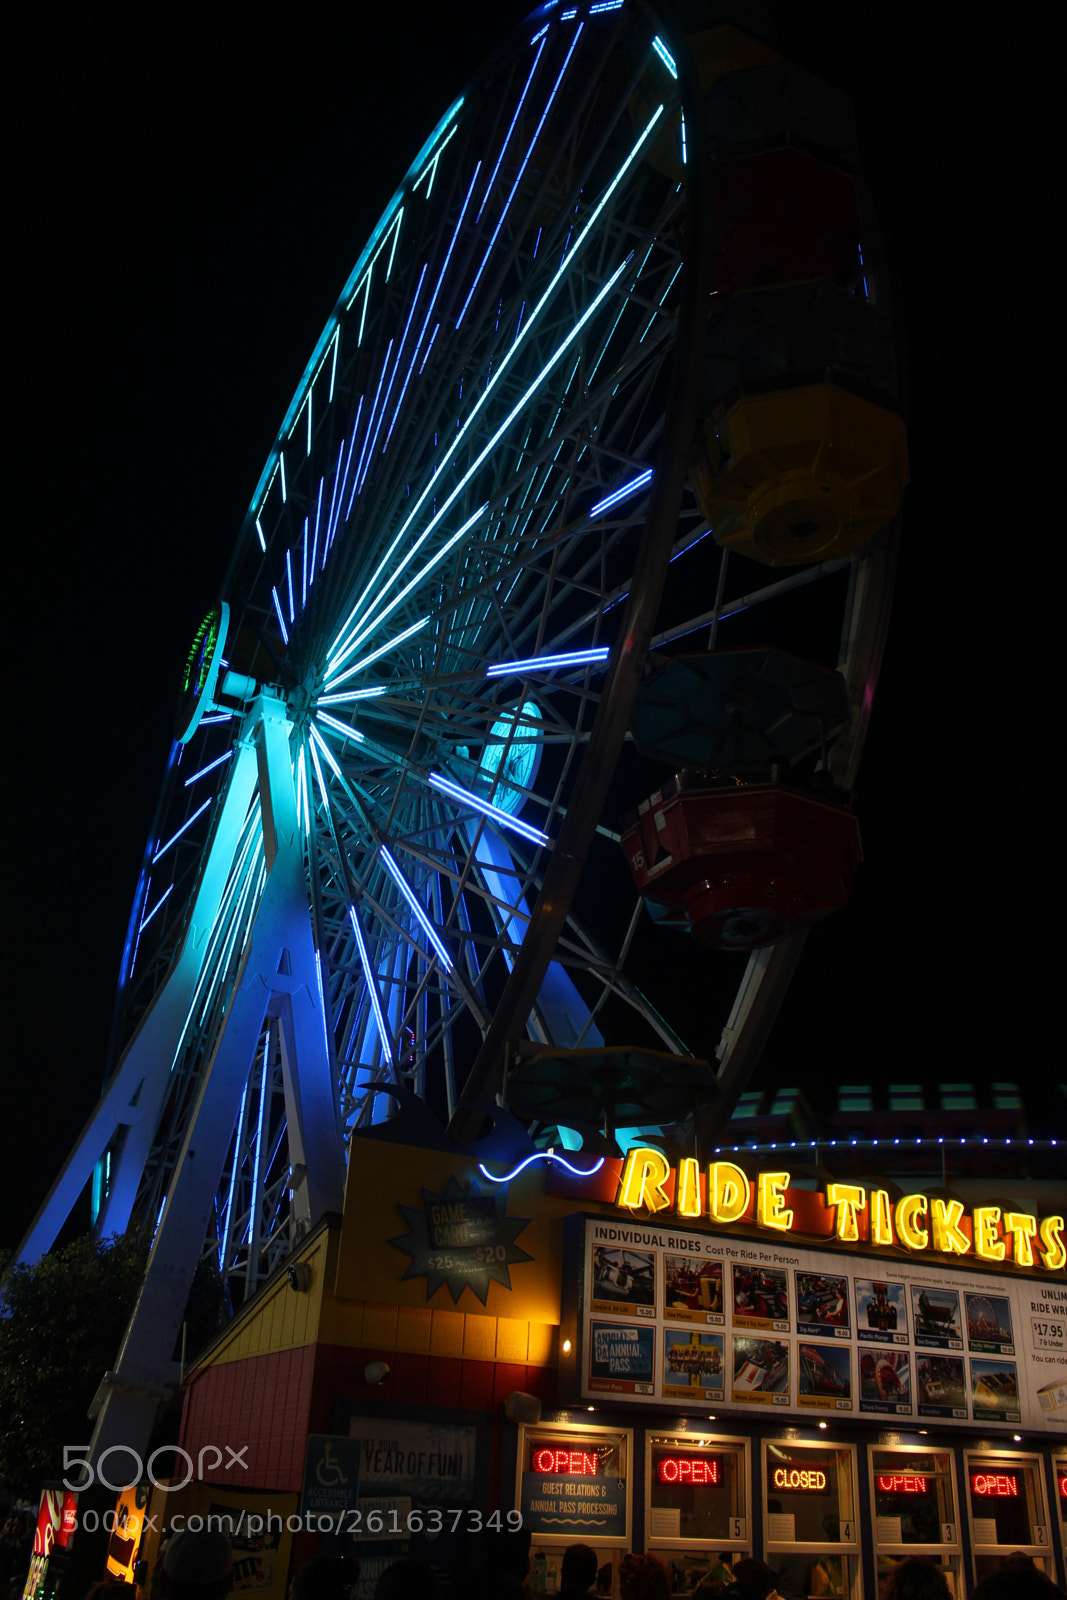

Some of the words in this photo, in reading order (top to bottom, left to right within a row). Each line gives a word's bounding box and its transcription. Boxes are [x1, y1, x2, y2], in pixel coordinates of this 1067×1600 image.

[631, 850, 644, 871] 15
[432, 1203, 467, 1224] GAME
[617, 1147, 794, 1230] RIDE
[827, 1183, 1067, 1271] TICKETS
[433, 1223, 469, 1247] CARD
[595, 1227, 665, 1247] INDIVIDUAL
[668, 1237, 701, 1252] RIDES
[428, 1256, 453, 1271] $25
[476, 1245, 507, 1264] $20
[706, 1245, 724, 1255] Cost
[726, 1247, 739, 1257] Per
[740, 1249, 758, 1260] Ride
[759, 1253, 772, 1262] Per
[773, 1254, 799, 1265] Person
[1031, 1302, 1050, 1313] RIDE
[1034, 1323, 1063, 1338] $17.95
[609, 1343, 640, 1358] ANNUAL
[1049, 1340, 1063, 1348] Under
[609, 1358, 630, 1373] PASS
[1032, 1354, 1044, 1363] You
[378, 1440, 399, 1452] YOUR
[365, 1449, 404, 1474] YEAR
[407, 1452, 427, 1475] OF
[428, 1453, 463, 1477] FUN!
[537, 1449, 598, 1476] OPEN
[662, 1459, 718, 1484] OPEN
[773, 1468, 826, 1489] CLOSED
[974, 1474, 1018, 1495] OPEN
[307, 1487, 353, 1499] ACCESSIBLE
[542, 1481, 563, 1495] GUEST
[565, 1483, 600, 1497] RELATIONS
[601, 1486, 607, 1497] &
[530, 1500, 557, 1514] ANNUAL
[559, 1501, 577, 1514] PASS
[577, 1502, 618, 1516] PROCESSING
[735, 1519, 741, 1537] 5
[844, 1522, 850, 1540] 4
[946, 1525, 952, 1542] 3
[1037, 1527, 1044, 1543] 2
